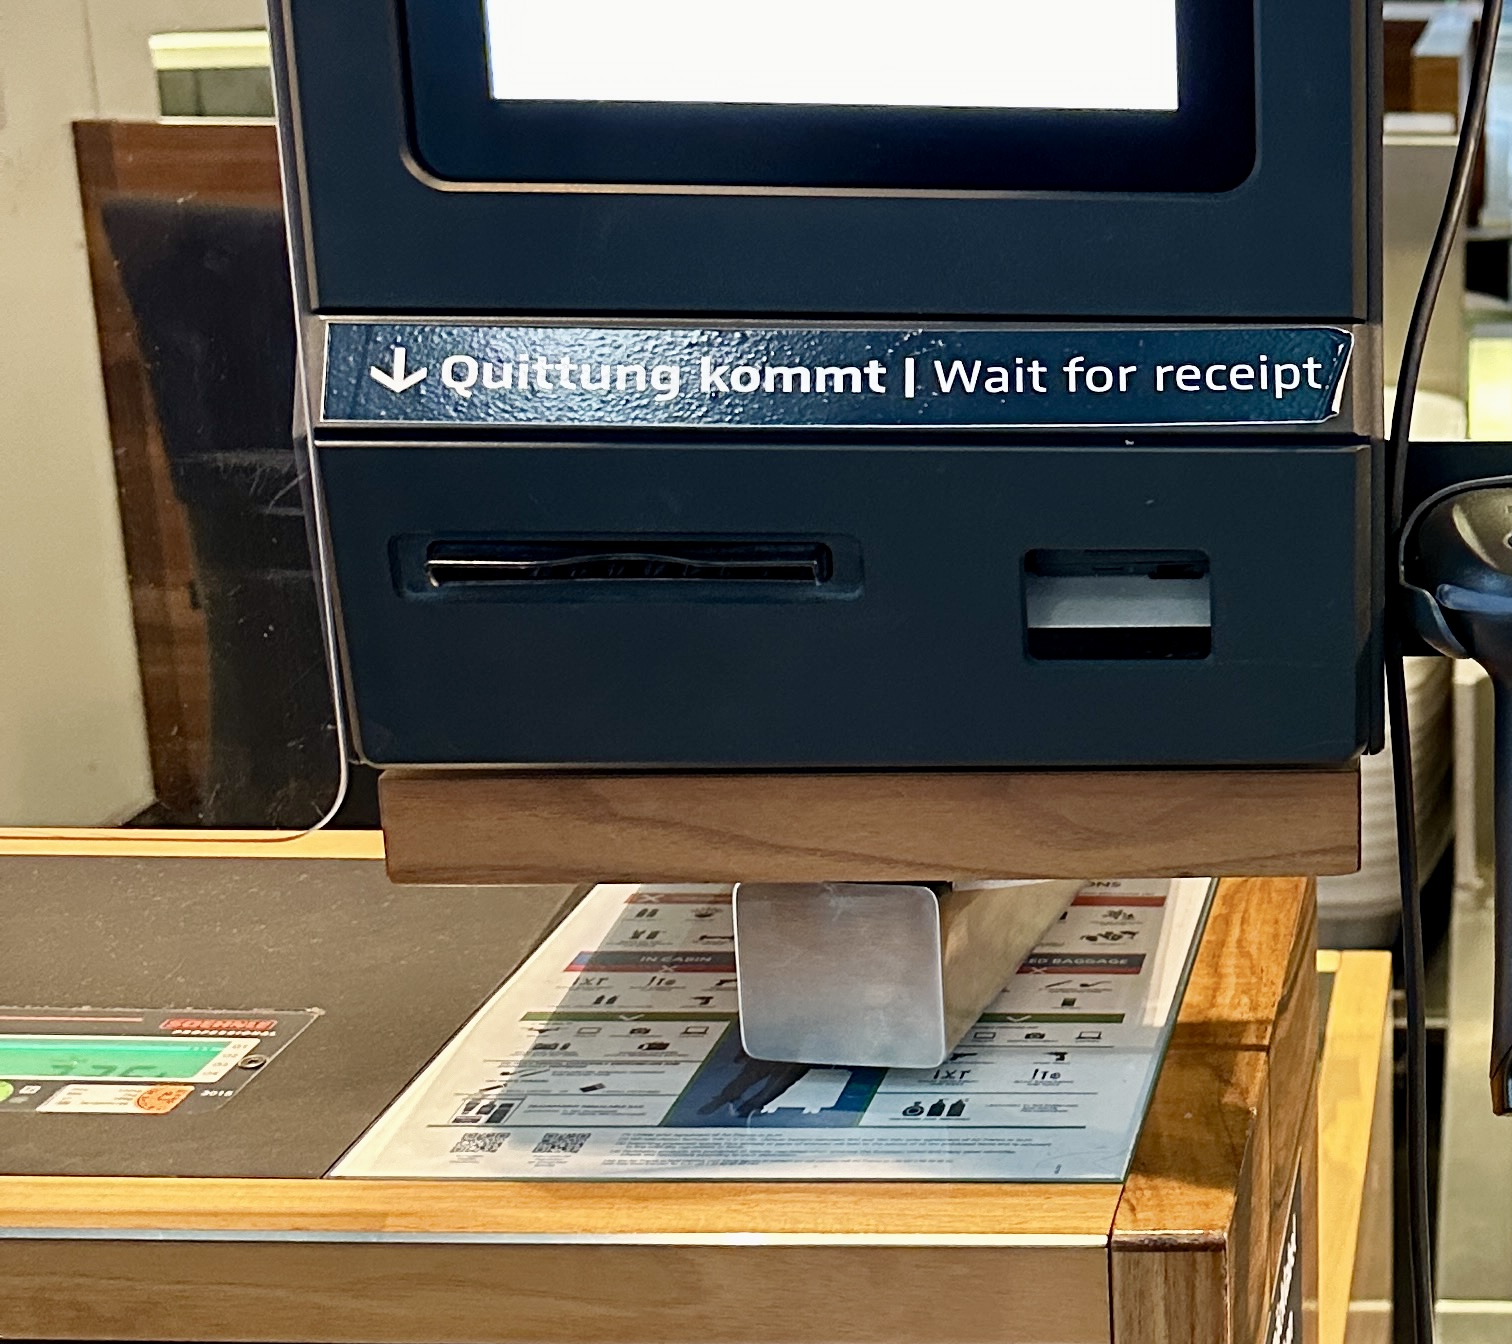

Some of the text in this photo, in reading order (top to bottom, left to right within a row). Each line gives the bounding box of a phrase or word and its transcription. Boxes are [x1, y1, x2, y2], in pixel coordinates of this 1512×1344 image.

[441, 354, 681, 401] Quittung
[701, 356, 886, 393] kommt
[933, 358, 1047, 393] Wait
[1063, 356, 1136, 393] for
[1155, 355, 1323, 399] receipt
